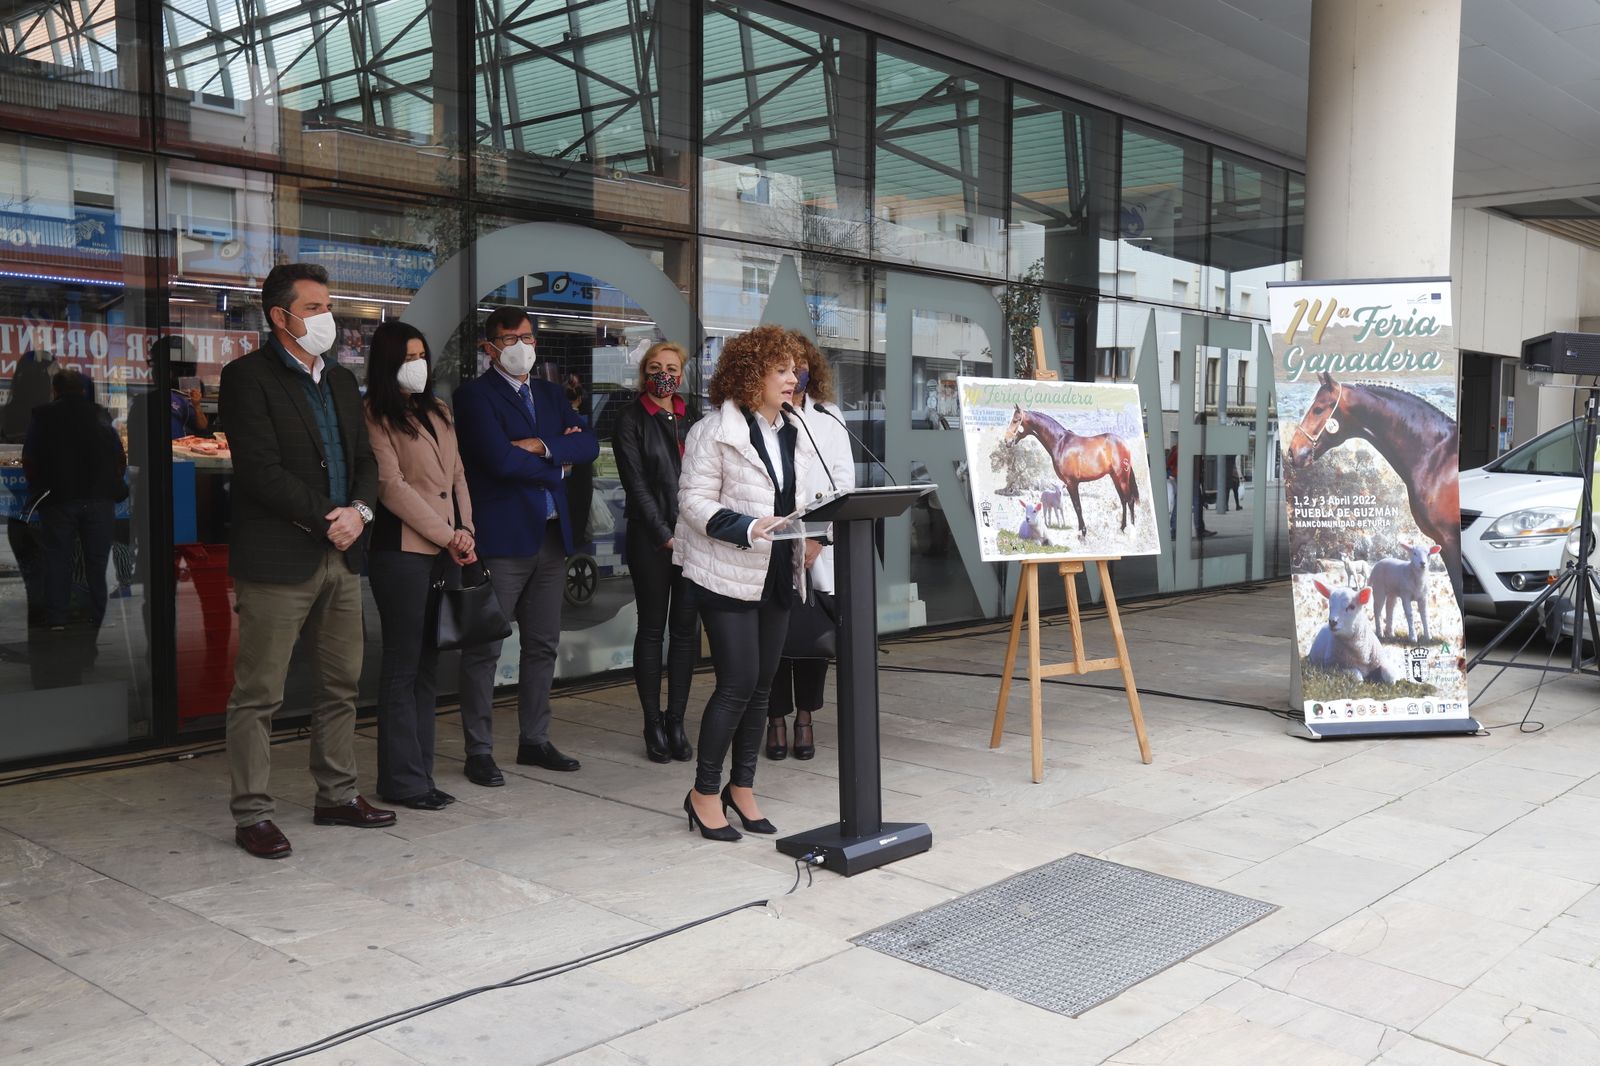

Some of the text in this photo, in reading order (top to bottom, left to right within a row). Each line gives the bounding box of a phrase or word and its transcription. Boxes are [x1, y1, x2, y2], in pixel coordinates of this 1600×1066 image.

[1352, 304, 1441, 344] Feria
[1282, 340, 1443, 382] Ganadera
[982, 384, 1022, 405] Feria
[1023, 387, 1095, 408] Ganadera
[1319, 496, 1326, 506] 3
[1328, 494, 1350, 506] Abril
[1352, 494, 1378, 506] 2022
[1294, 504, 1399, 518] PUEBLA DE GUZMÁN
[1296, 519, 1390, 528] MANCOMUNIDAD BETURIA
